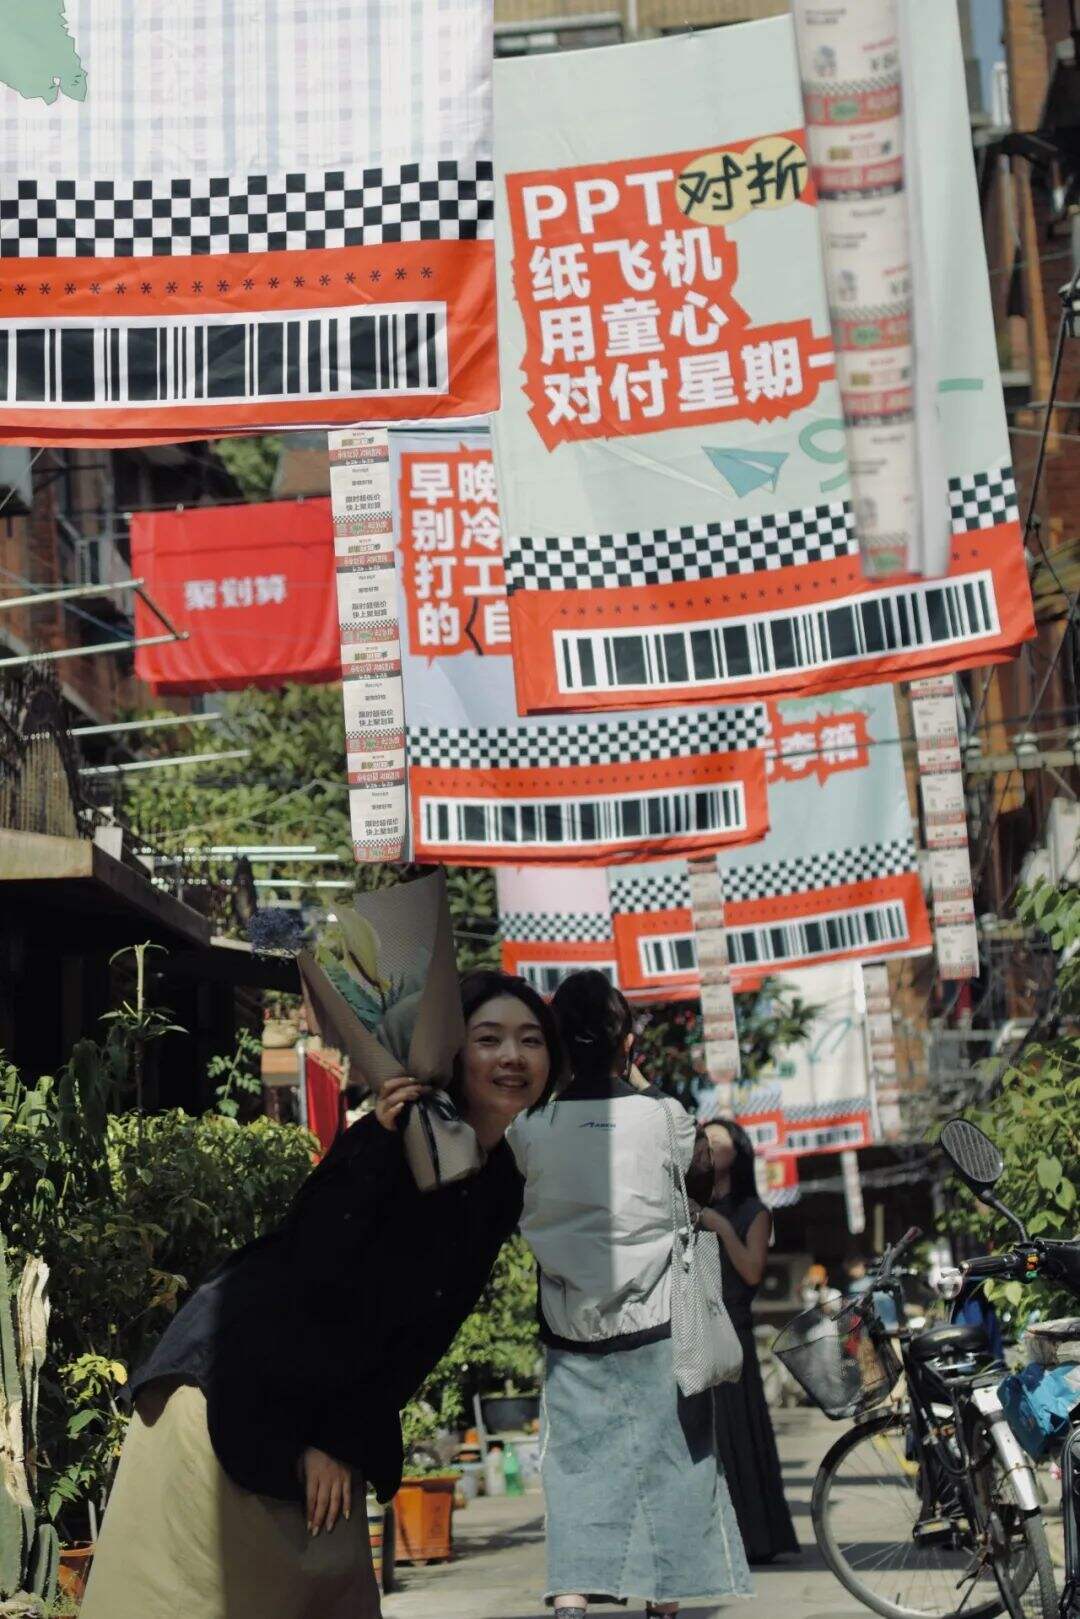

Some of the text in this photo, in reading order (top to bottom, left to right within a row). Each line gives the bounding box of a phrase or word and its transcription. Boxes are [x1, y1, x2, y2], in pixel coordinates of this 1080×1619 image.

[522, 168, 674, 240] PPT
[528, 226, 723, 302] 纸飞机
[539, 290, 730, 365] 用童心
[544, 337, 836, 427] 对付星期一
[409, 460, 499, 506] 早晚
[411, 506, 501, 552] 别冷
[414, 555, 508, 600] 打工
